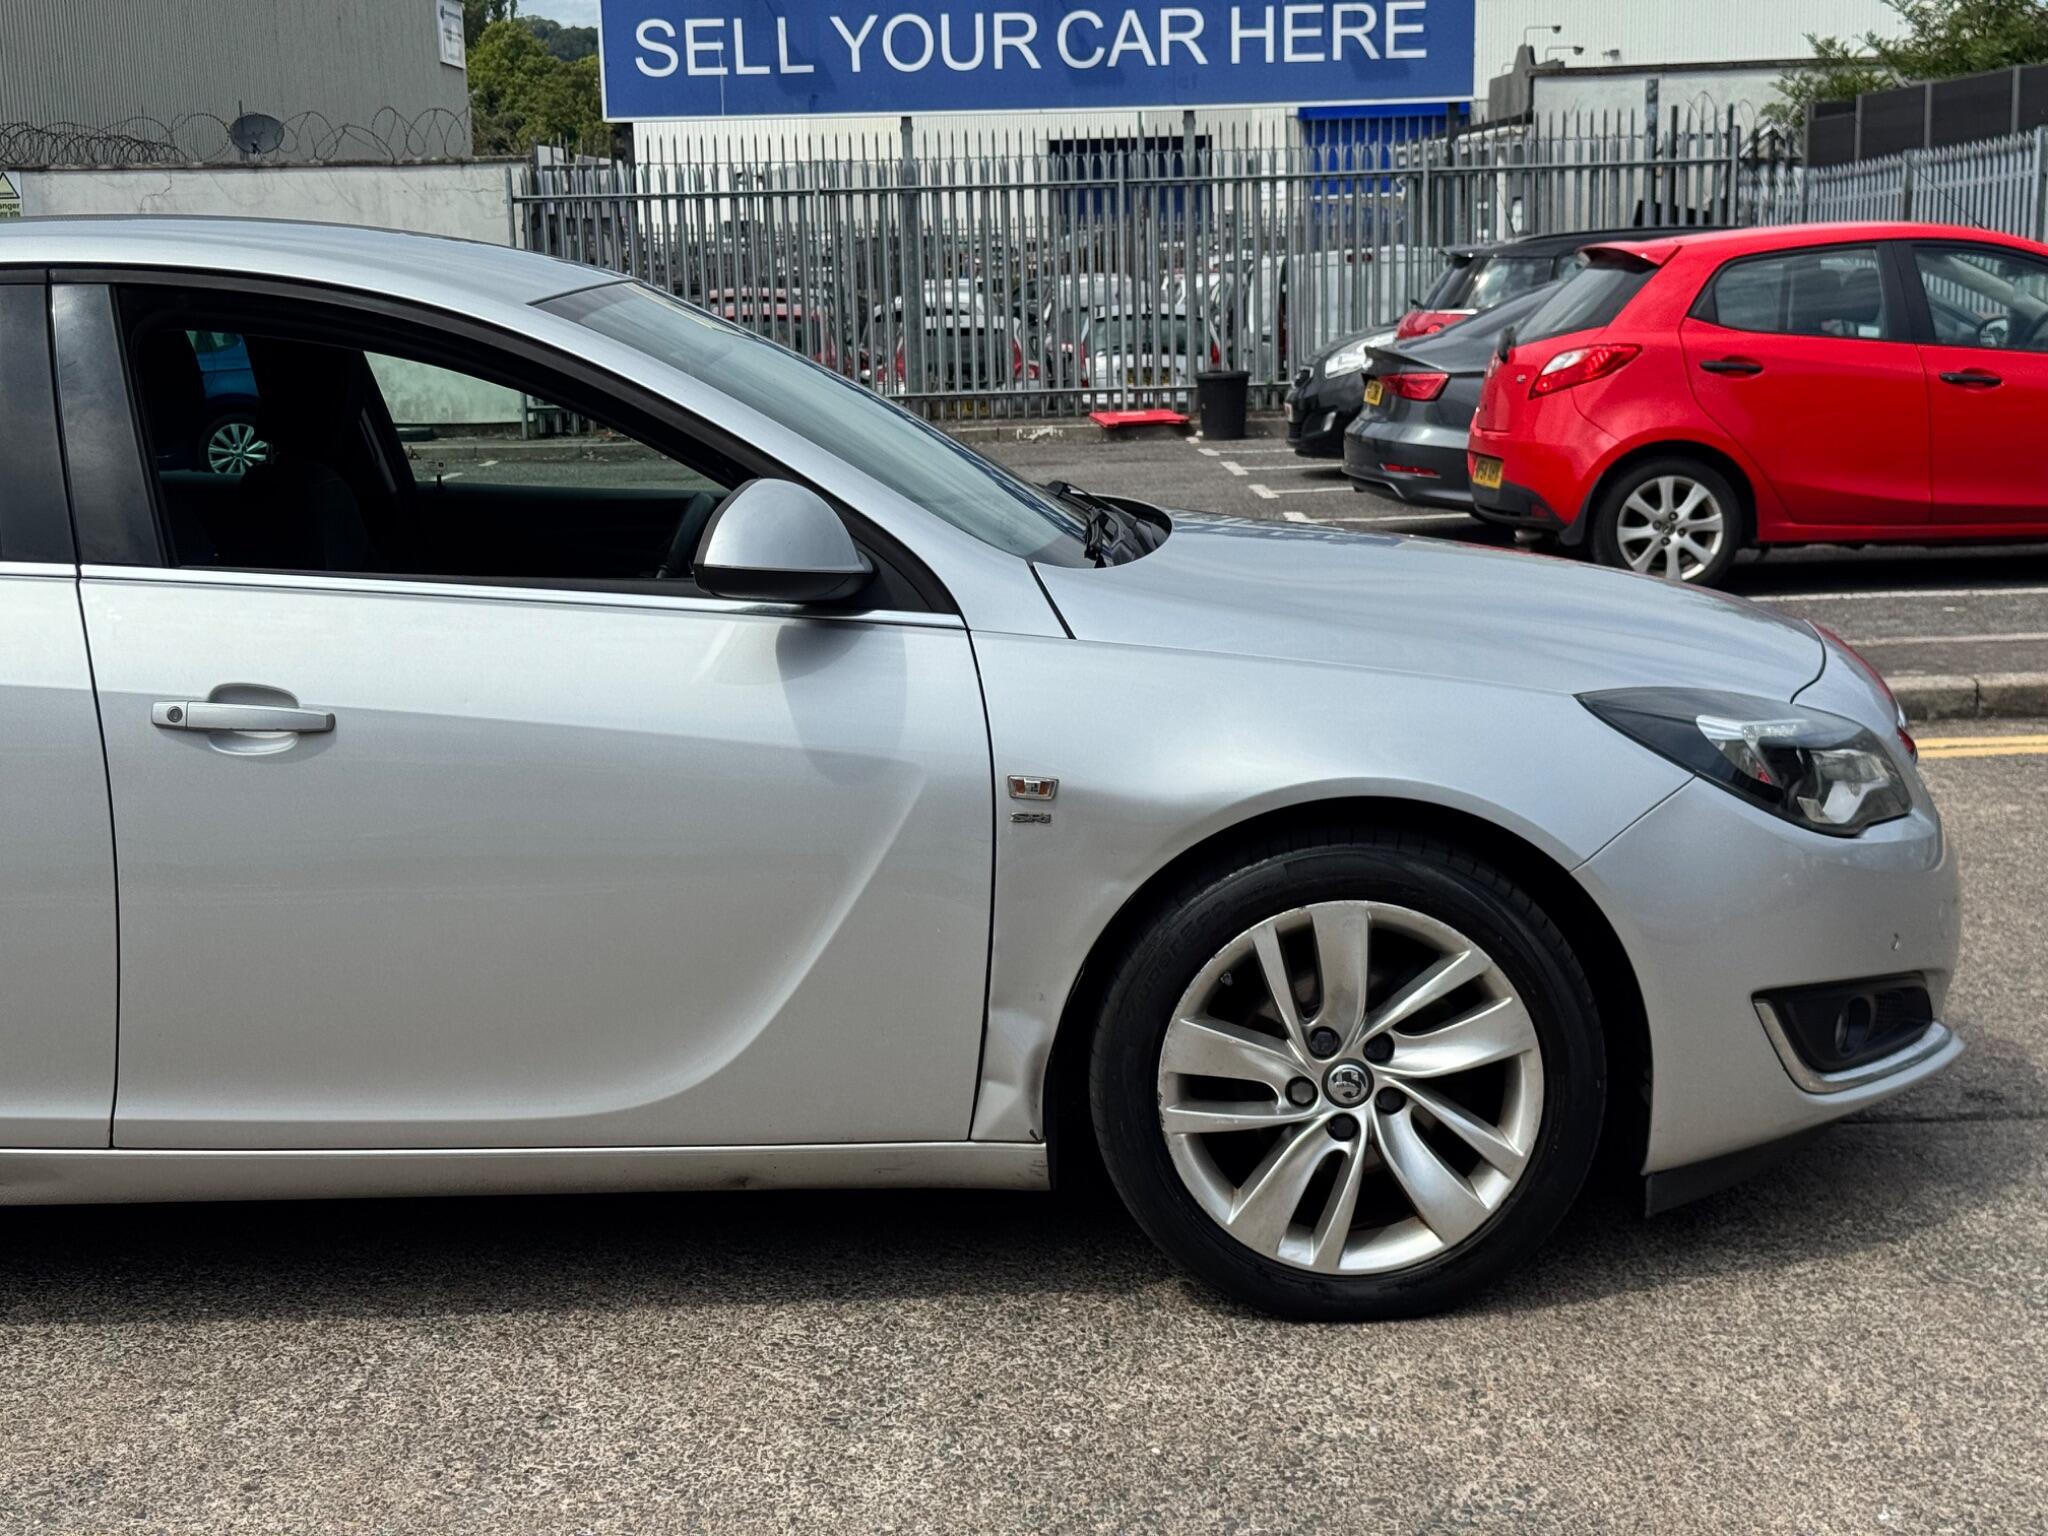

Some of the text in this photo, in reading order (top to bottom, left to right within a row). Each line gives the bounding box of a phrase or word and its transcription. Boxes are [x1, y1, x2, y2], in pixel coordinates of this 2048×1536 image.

[635, 1, 1426, 76] SELL YOUR CAR HERE
